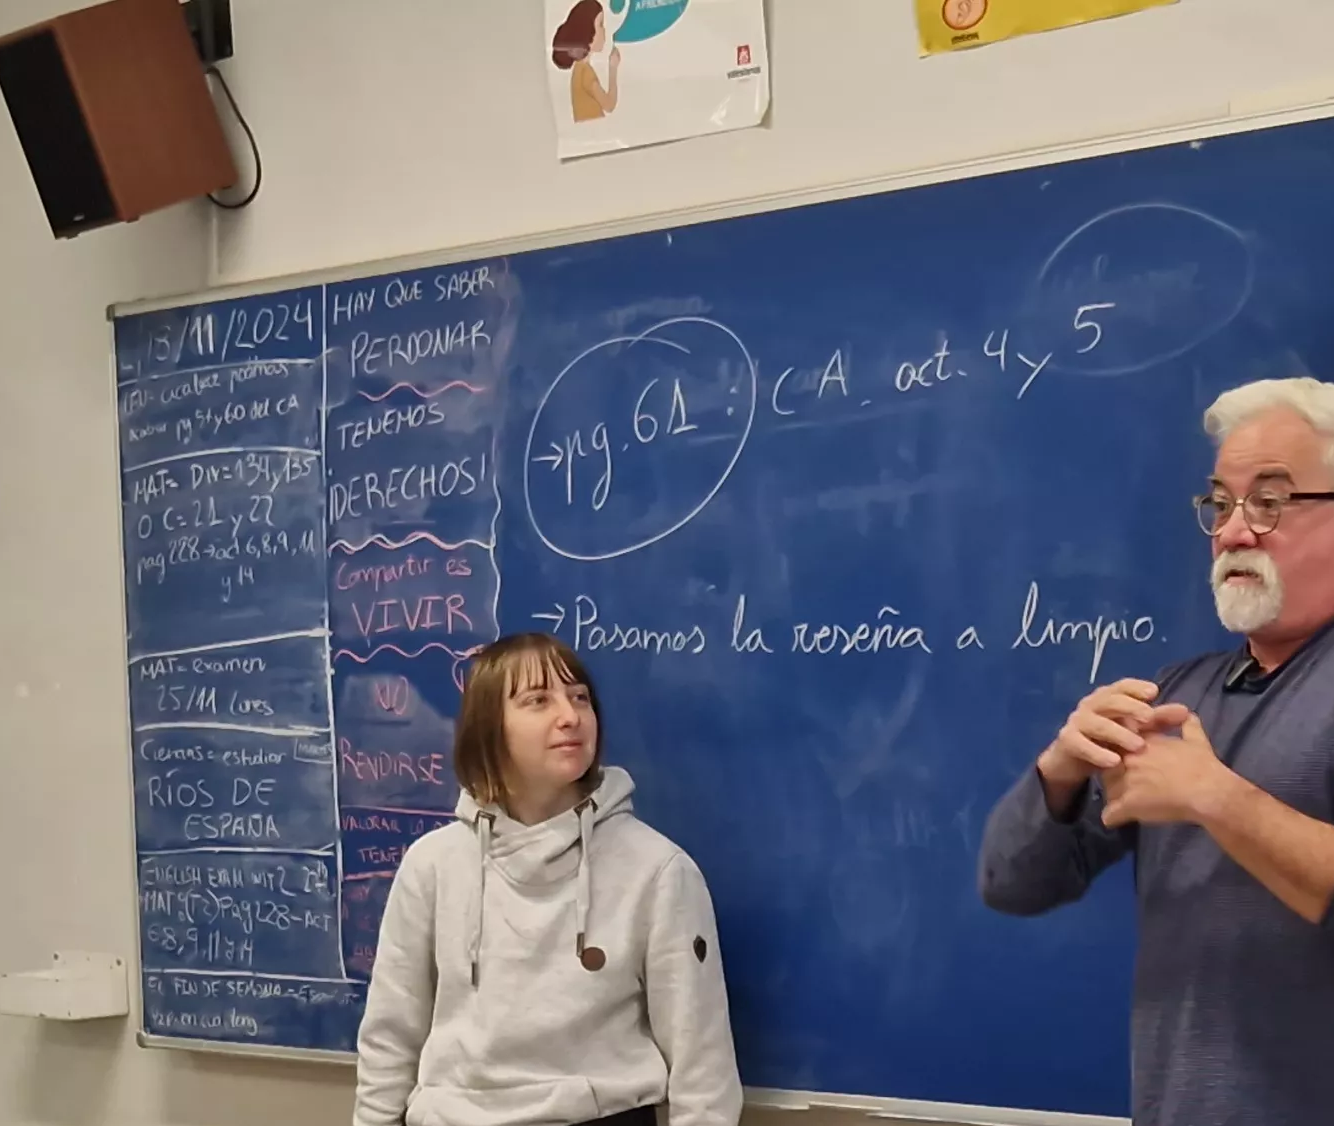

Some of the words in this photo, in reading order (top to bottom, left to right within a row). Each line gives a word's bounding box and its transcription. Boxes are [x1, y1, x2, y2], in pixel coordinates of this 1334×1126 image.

[333, 288, 375, 326] HAY
[435, 266, 495, 301] SABER
[351, 320, 491, 378] PERDONAR
[982, 328, 1009, 372] 4
[1016, 351, 1054, 400] y
[1073, 302, 1116, 354] 5
[337, 402, 445, 451] TENEMOS
[352, 594, 474, 637] VIVIR
[573, 593, 707, 655] Pasamos
[730, 593, 774, 654] la
[791, 604, 934, 656] reseña
[956, 625, 985, 651] a
[157, 685, 217, 715] 25/11
[341, 737, 445, 786] RENDIRSE
[148, 768, 215, 808] RÍOS
[232, 777, 278, 807] DE
